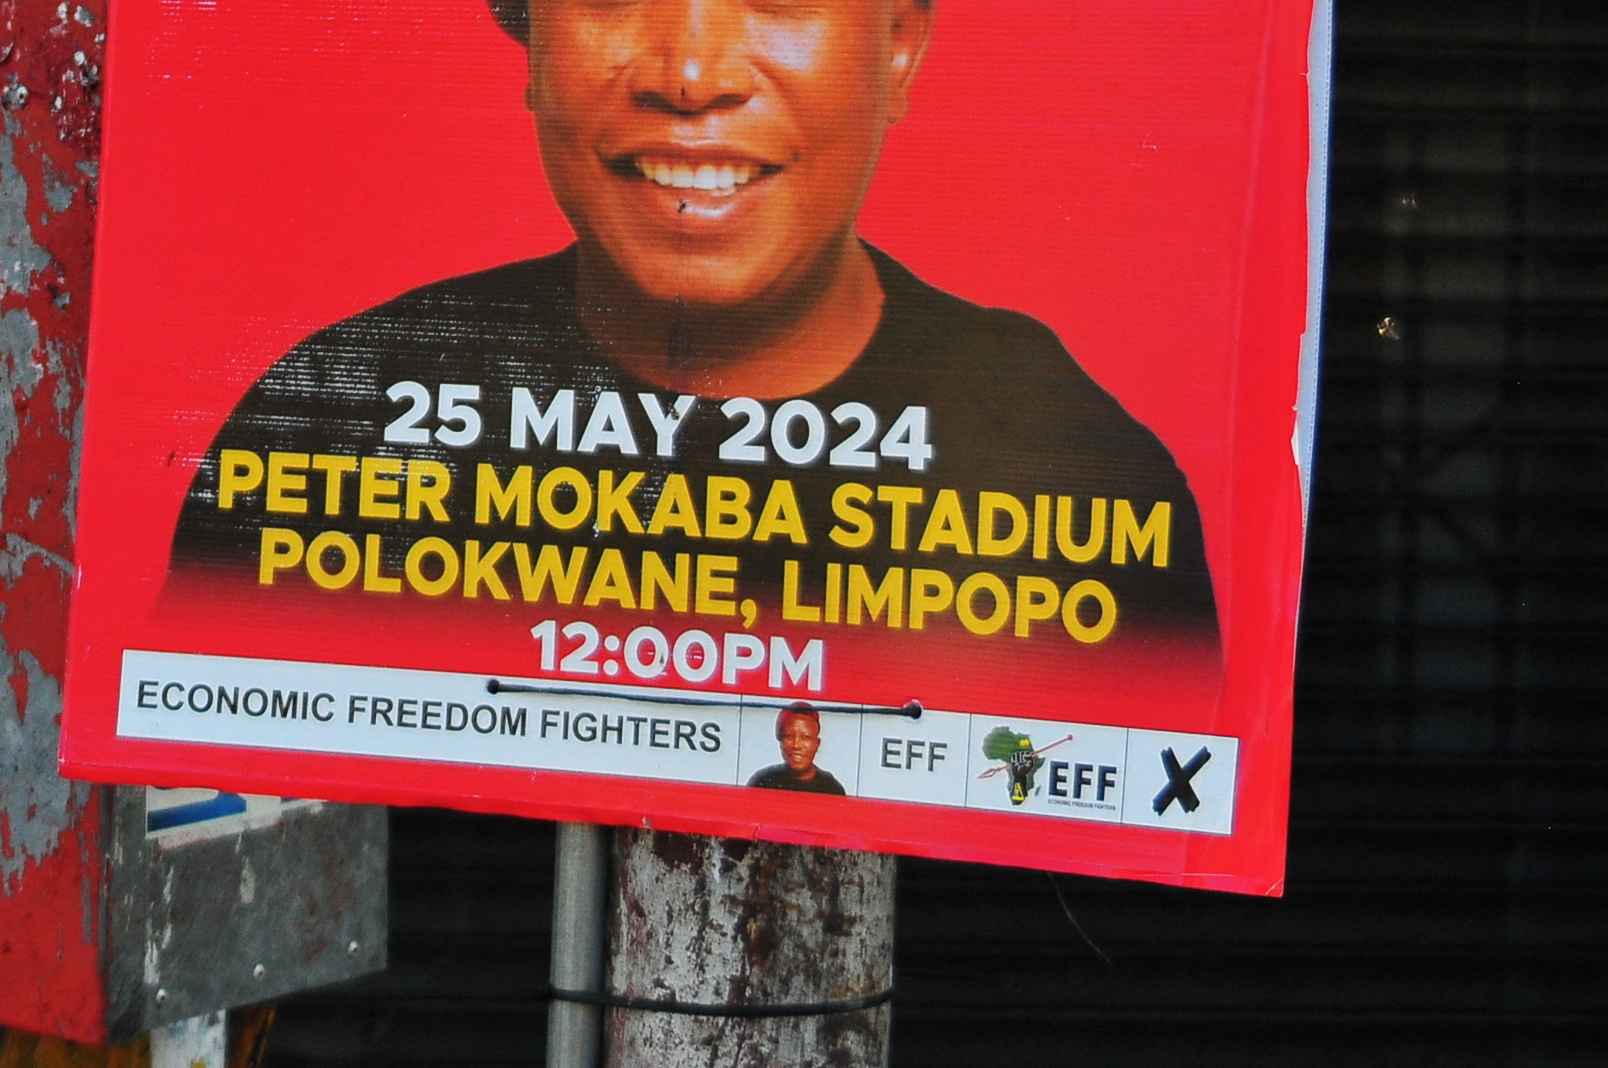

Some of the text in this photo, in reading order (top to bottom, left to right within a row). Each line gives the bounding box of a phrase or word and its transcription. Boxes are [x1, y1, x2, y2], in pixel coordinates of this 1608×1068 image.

[383, 380, 932, 471] 25 MAY 2024
[218, 448, 1171, 568] PETER MOKABA STADIUM
[258, 527, 1117, 644] POLOKWANE, LIMPOPO
[530, 619, 823, 692] 12:00PM
[137, 679, 722, 754] ECONOMIC FREEDOM FIGHTERS
[881, 737, 948, 773] EFF
[1048, 760, 1117, 802] EFF
